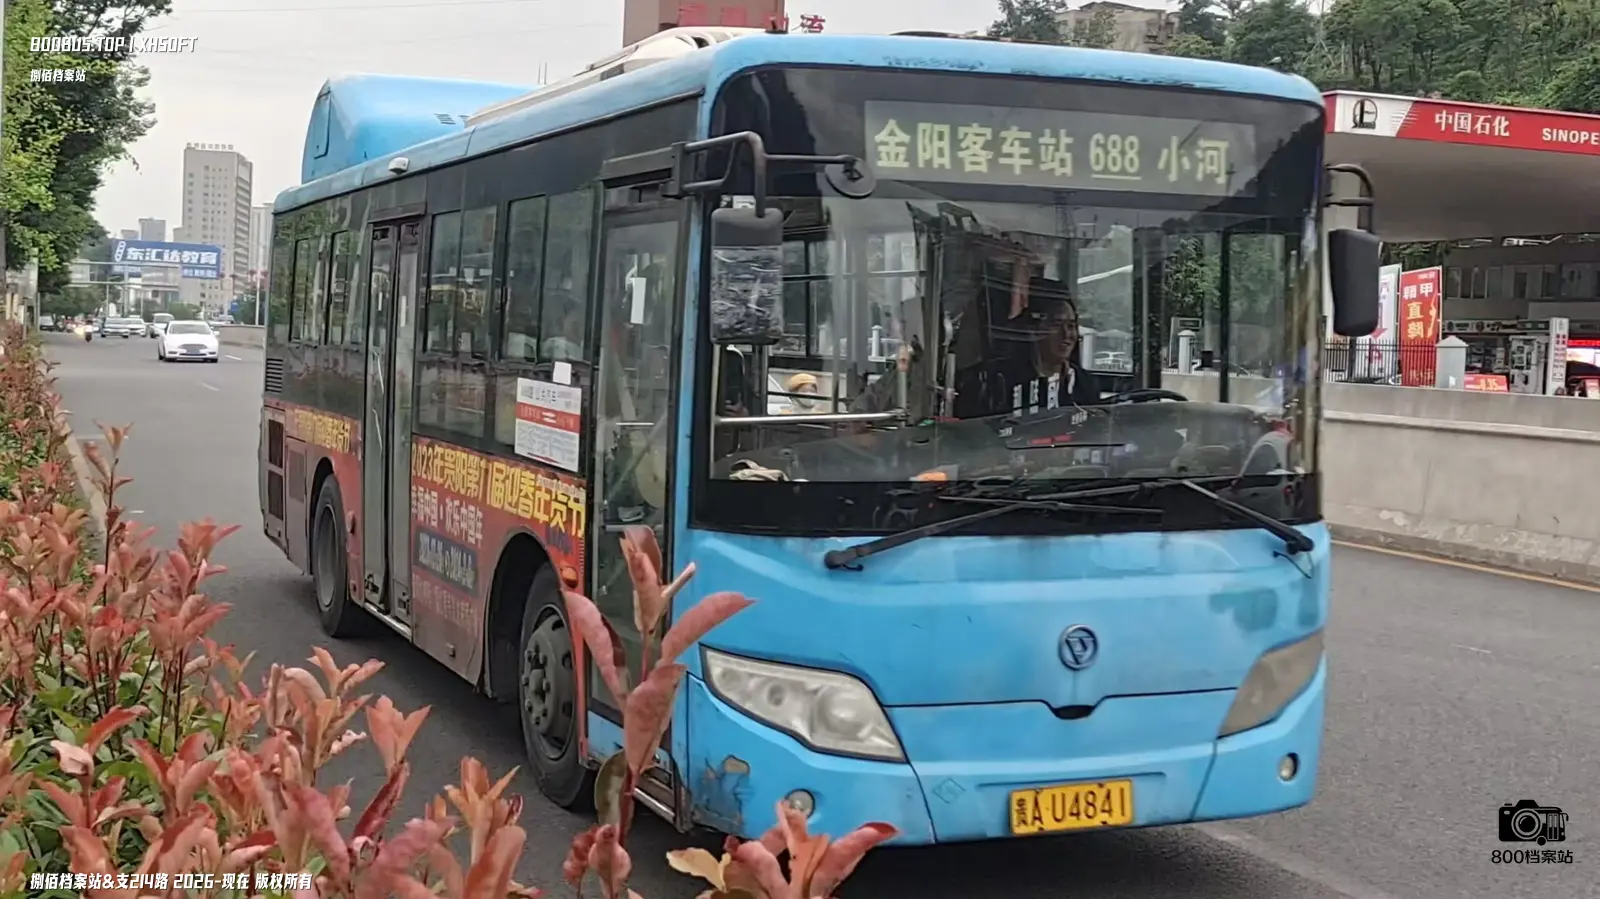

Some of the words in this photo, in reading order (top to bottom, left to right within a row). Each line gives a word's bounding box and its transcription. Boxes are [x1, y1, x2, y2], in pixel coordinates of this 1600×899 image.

[1435, 110, 1510, 137] 中国石化
[874, 118, 1074, 177] 金阳客车站
[1089, 132, 1141, 175] 688
[1157, 135, 1230, 184] 小河
